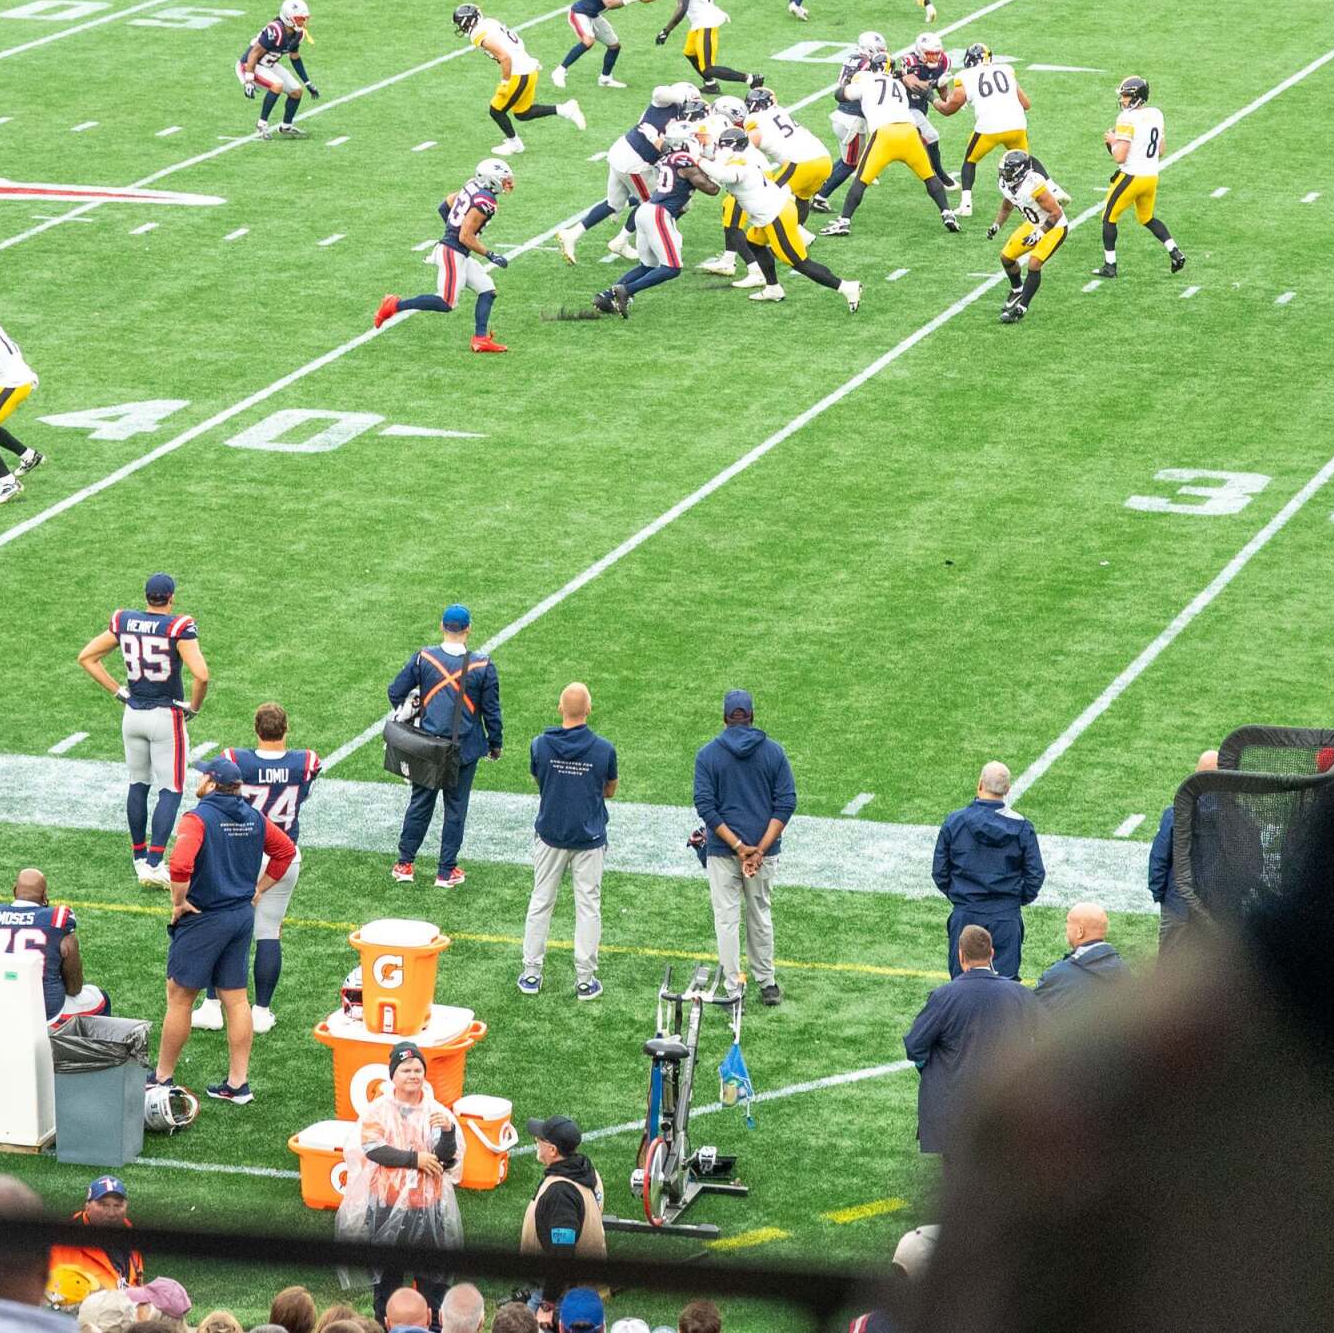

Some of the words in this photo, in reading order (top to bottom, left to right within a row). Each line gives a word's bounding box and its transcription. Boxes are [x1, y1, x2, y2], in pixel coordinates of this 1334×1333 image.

[875, 78, 905, 105] 74
[979, 70, 1009, 96] 60
[1147, 128, 1158, 157] 8
[35, 399, 385, 453] 40
[127, 619, 160, 634] HENRY
[119, 636, 172, 682] 85
[258, 768, 289, 784] LOMU
[240, 784, 298, 831] 74
[374, 955, 404, 989] G
